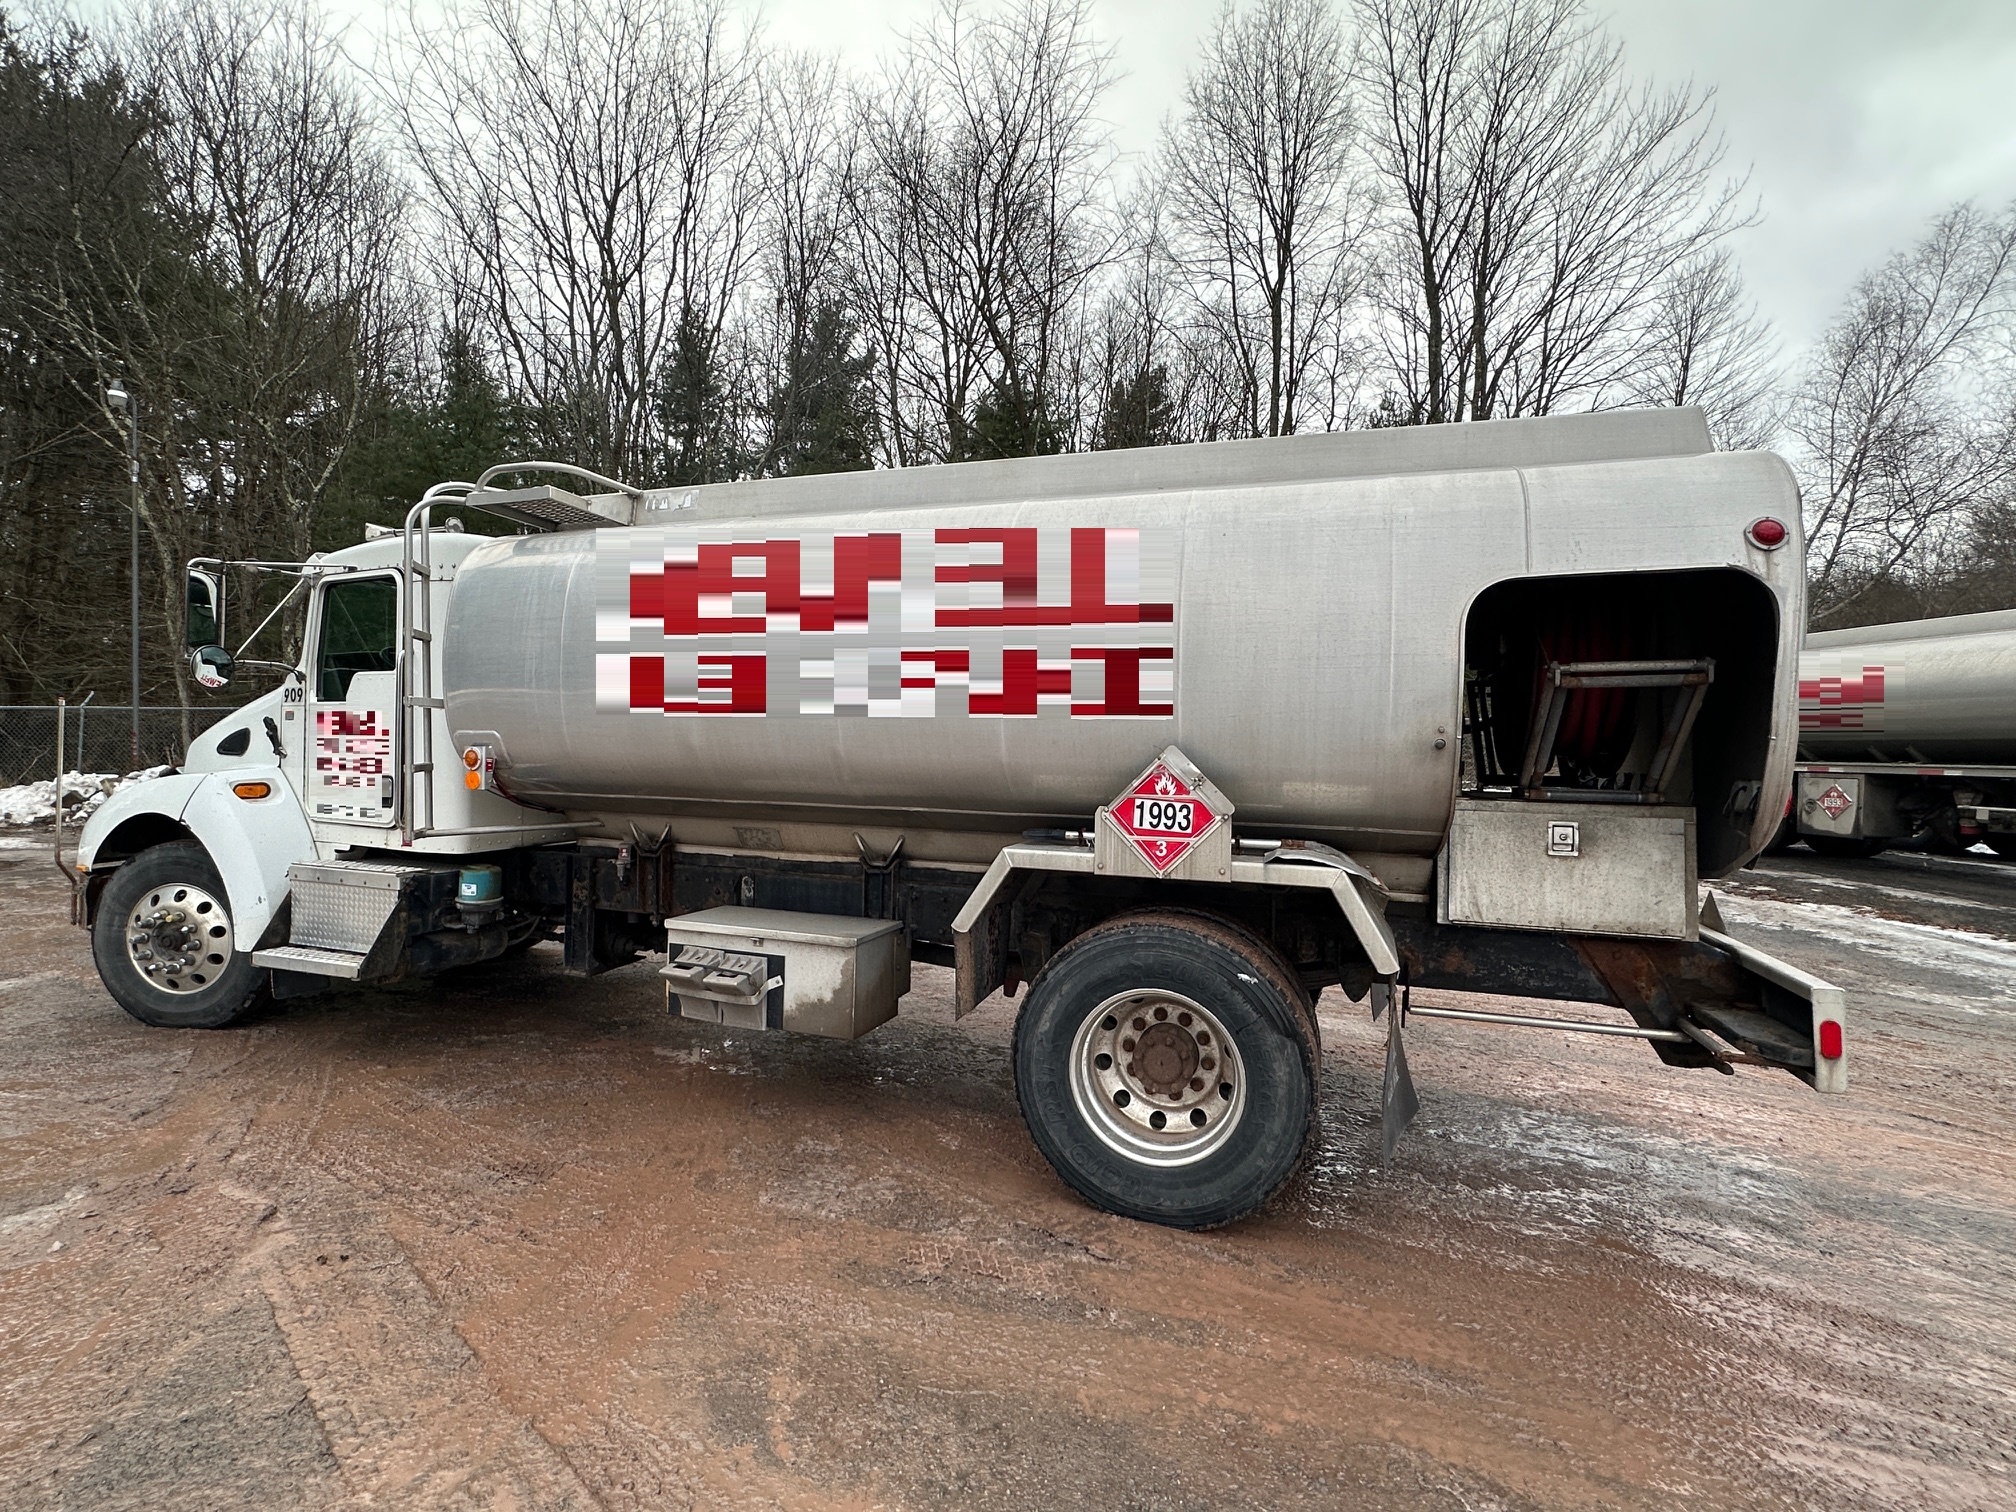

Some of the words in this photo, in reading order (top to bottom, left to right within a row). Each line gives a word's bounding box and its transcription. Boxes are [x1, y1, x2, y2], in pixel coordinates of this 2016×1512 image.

[284, 688, 303, 702] 909
[1826, 798, 1842, 807] 1993
[1135, 800, 1191, 831] 1993
[1155, 840, 1167, 856] 3
